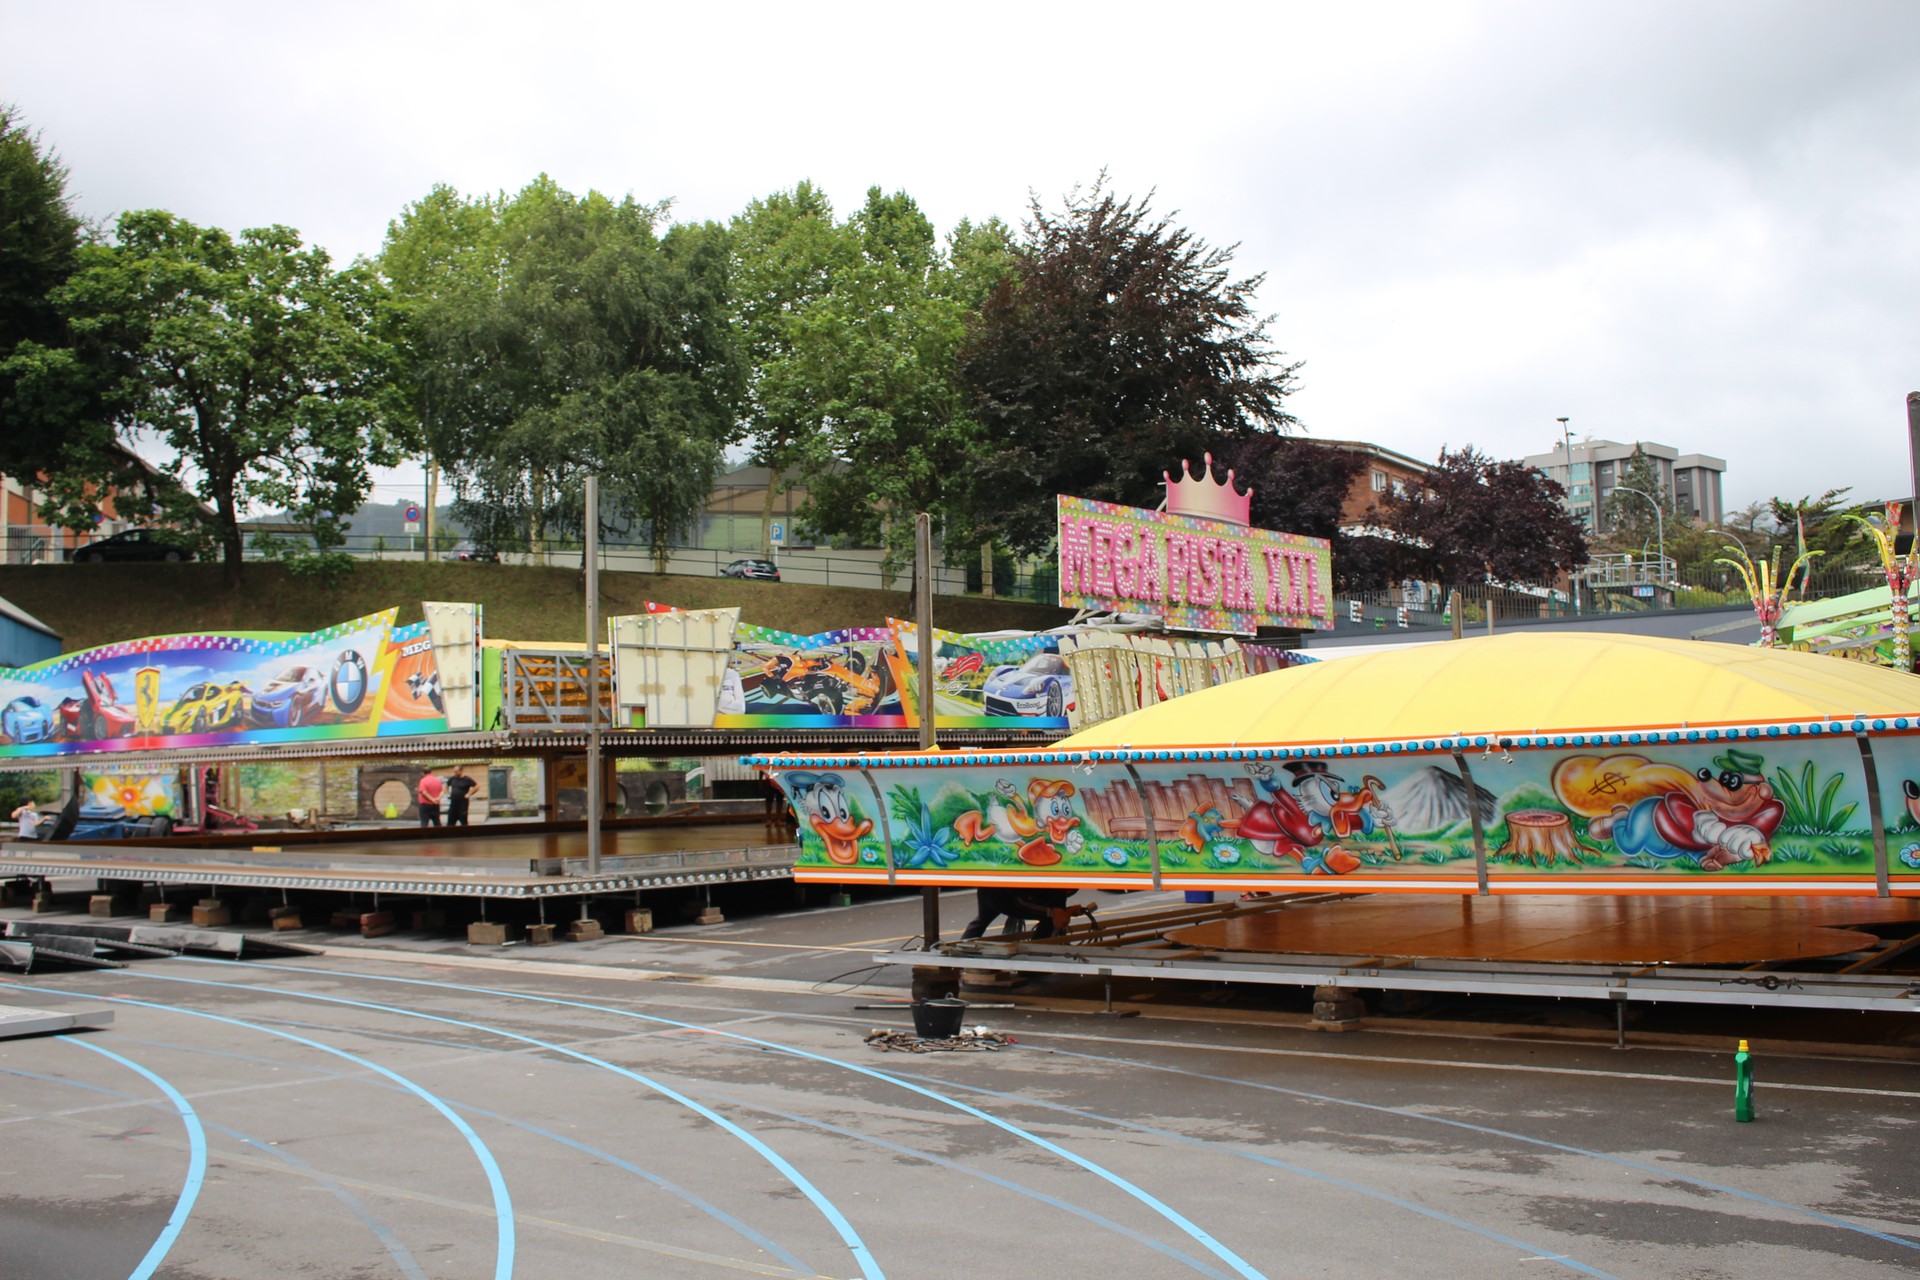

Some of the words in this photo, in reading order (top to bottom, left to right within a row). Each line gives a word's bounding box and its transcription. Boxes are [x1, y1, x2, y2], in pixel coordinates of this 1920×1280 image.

[1061, 515, 1163, 601] MEGA
[1165, 531, 1258, 610] PISTA
[1262, 545, 1326, 617] XXL
[402, 640, 432, 658] MEG
